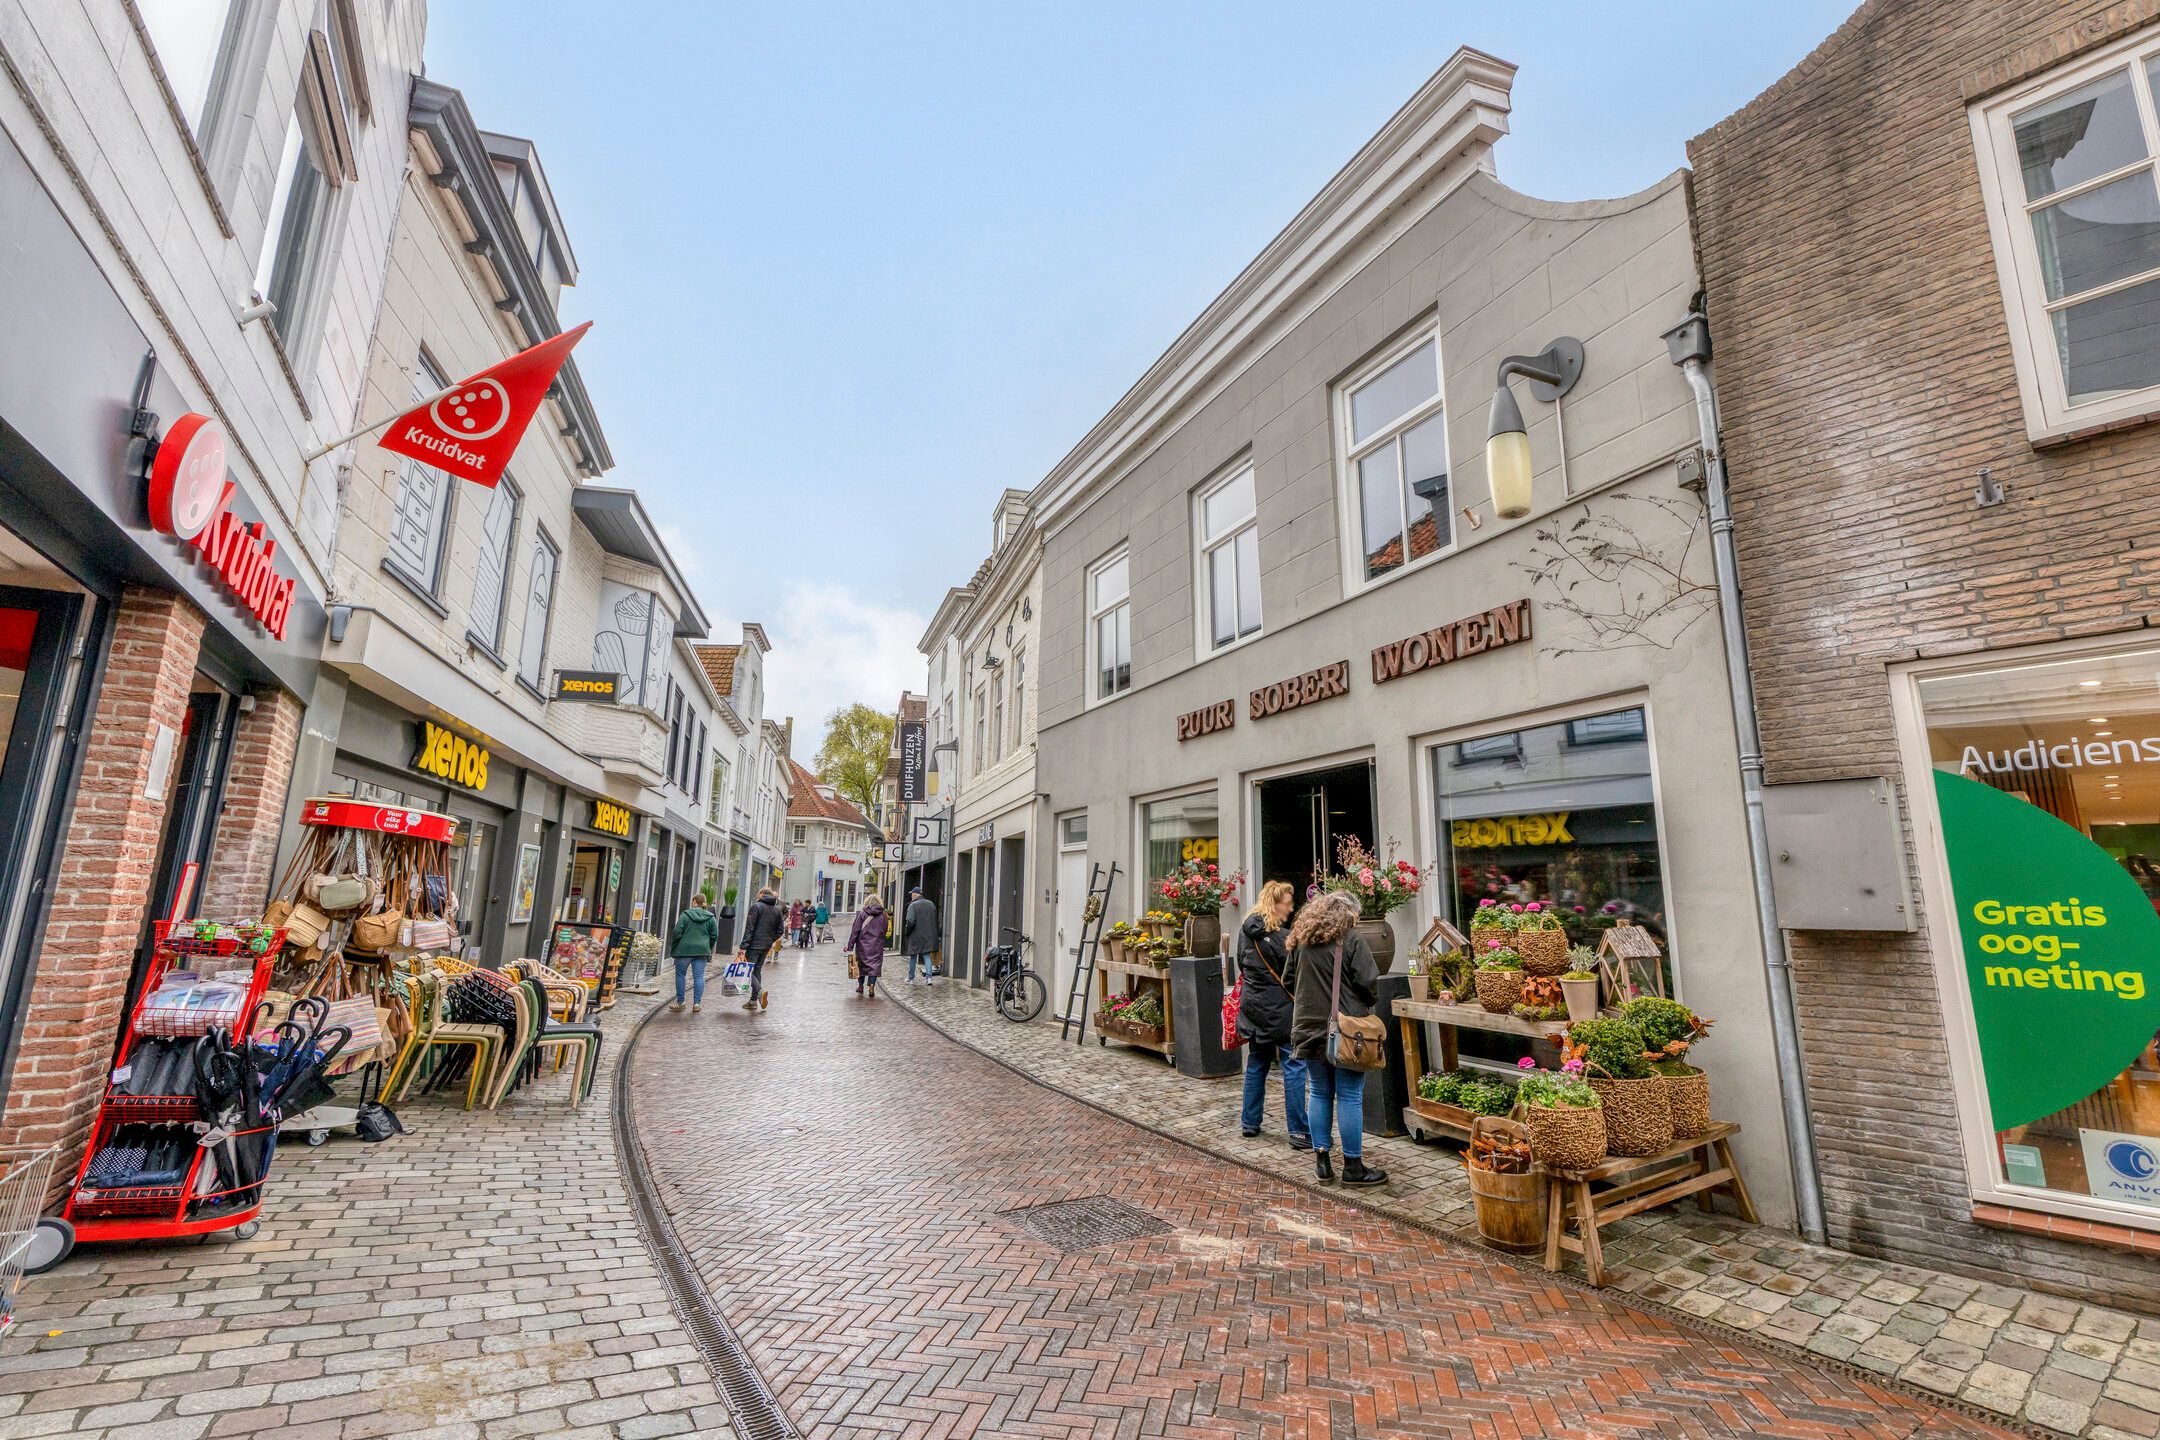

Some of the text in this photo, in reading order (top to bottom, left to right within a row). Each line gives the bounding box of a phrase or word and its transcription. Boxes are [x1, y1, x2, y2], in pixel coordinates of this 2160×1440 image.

[404, 426, 486, 470] Kruidvat
[194, 480, 296, 641] Kruidvat
[562, 680, 614, 693] xenos
[1177, 599, 1531, 742] PUUR SOBER WONEN
[418, 721, 489, 791] xenos
[904, 733, 915, 799] DUIFHUIZEN
[387, 810, 403, 818] Voor
[594, 800, 630, 837] xenos
[705, 836, 727, 860] LUNA
[1973, 897, 2107, 927] Gratis
[1979, 934, 2080, 961] oog-
[1984, 961, 2145, 1000] meting
